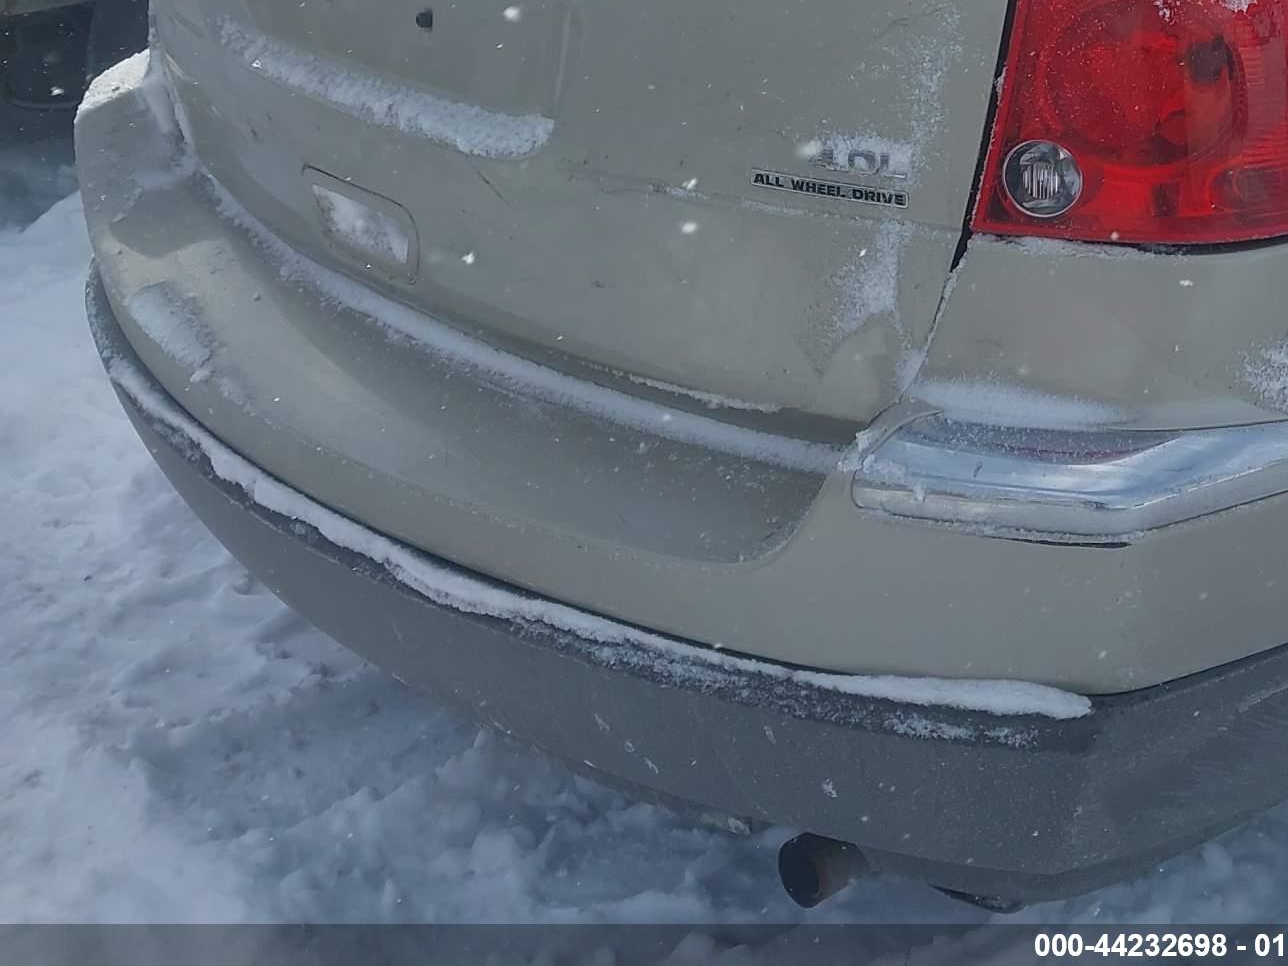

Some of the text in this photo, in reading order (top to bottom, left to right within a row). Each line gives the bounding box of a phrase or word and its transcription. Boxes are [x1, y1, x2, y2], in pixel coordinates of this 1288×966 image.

[754, 173, 906, 205] ALL WHEEL DRIVE
